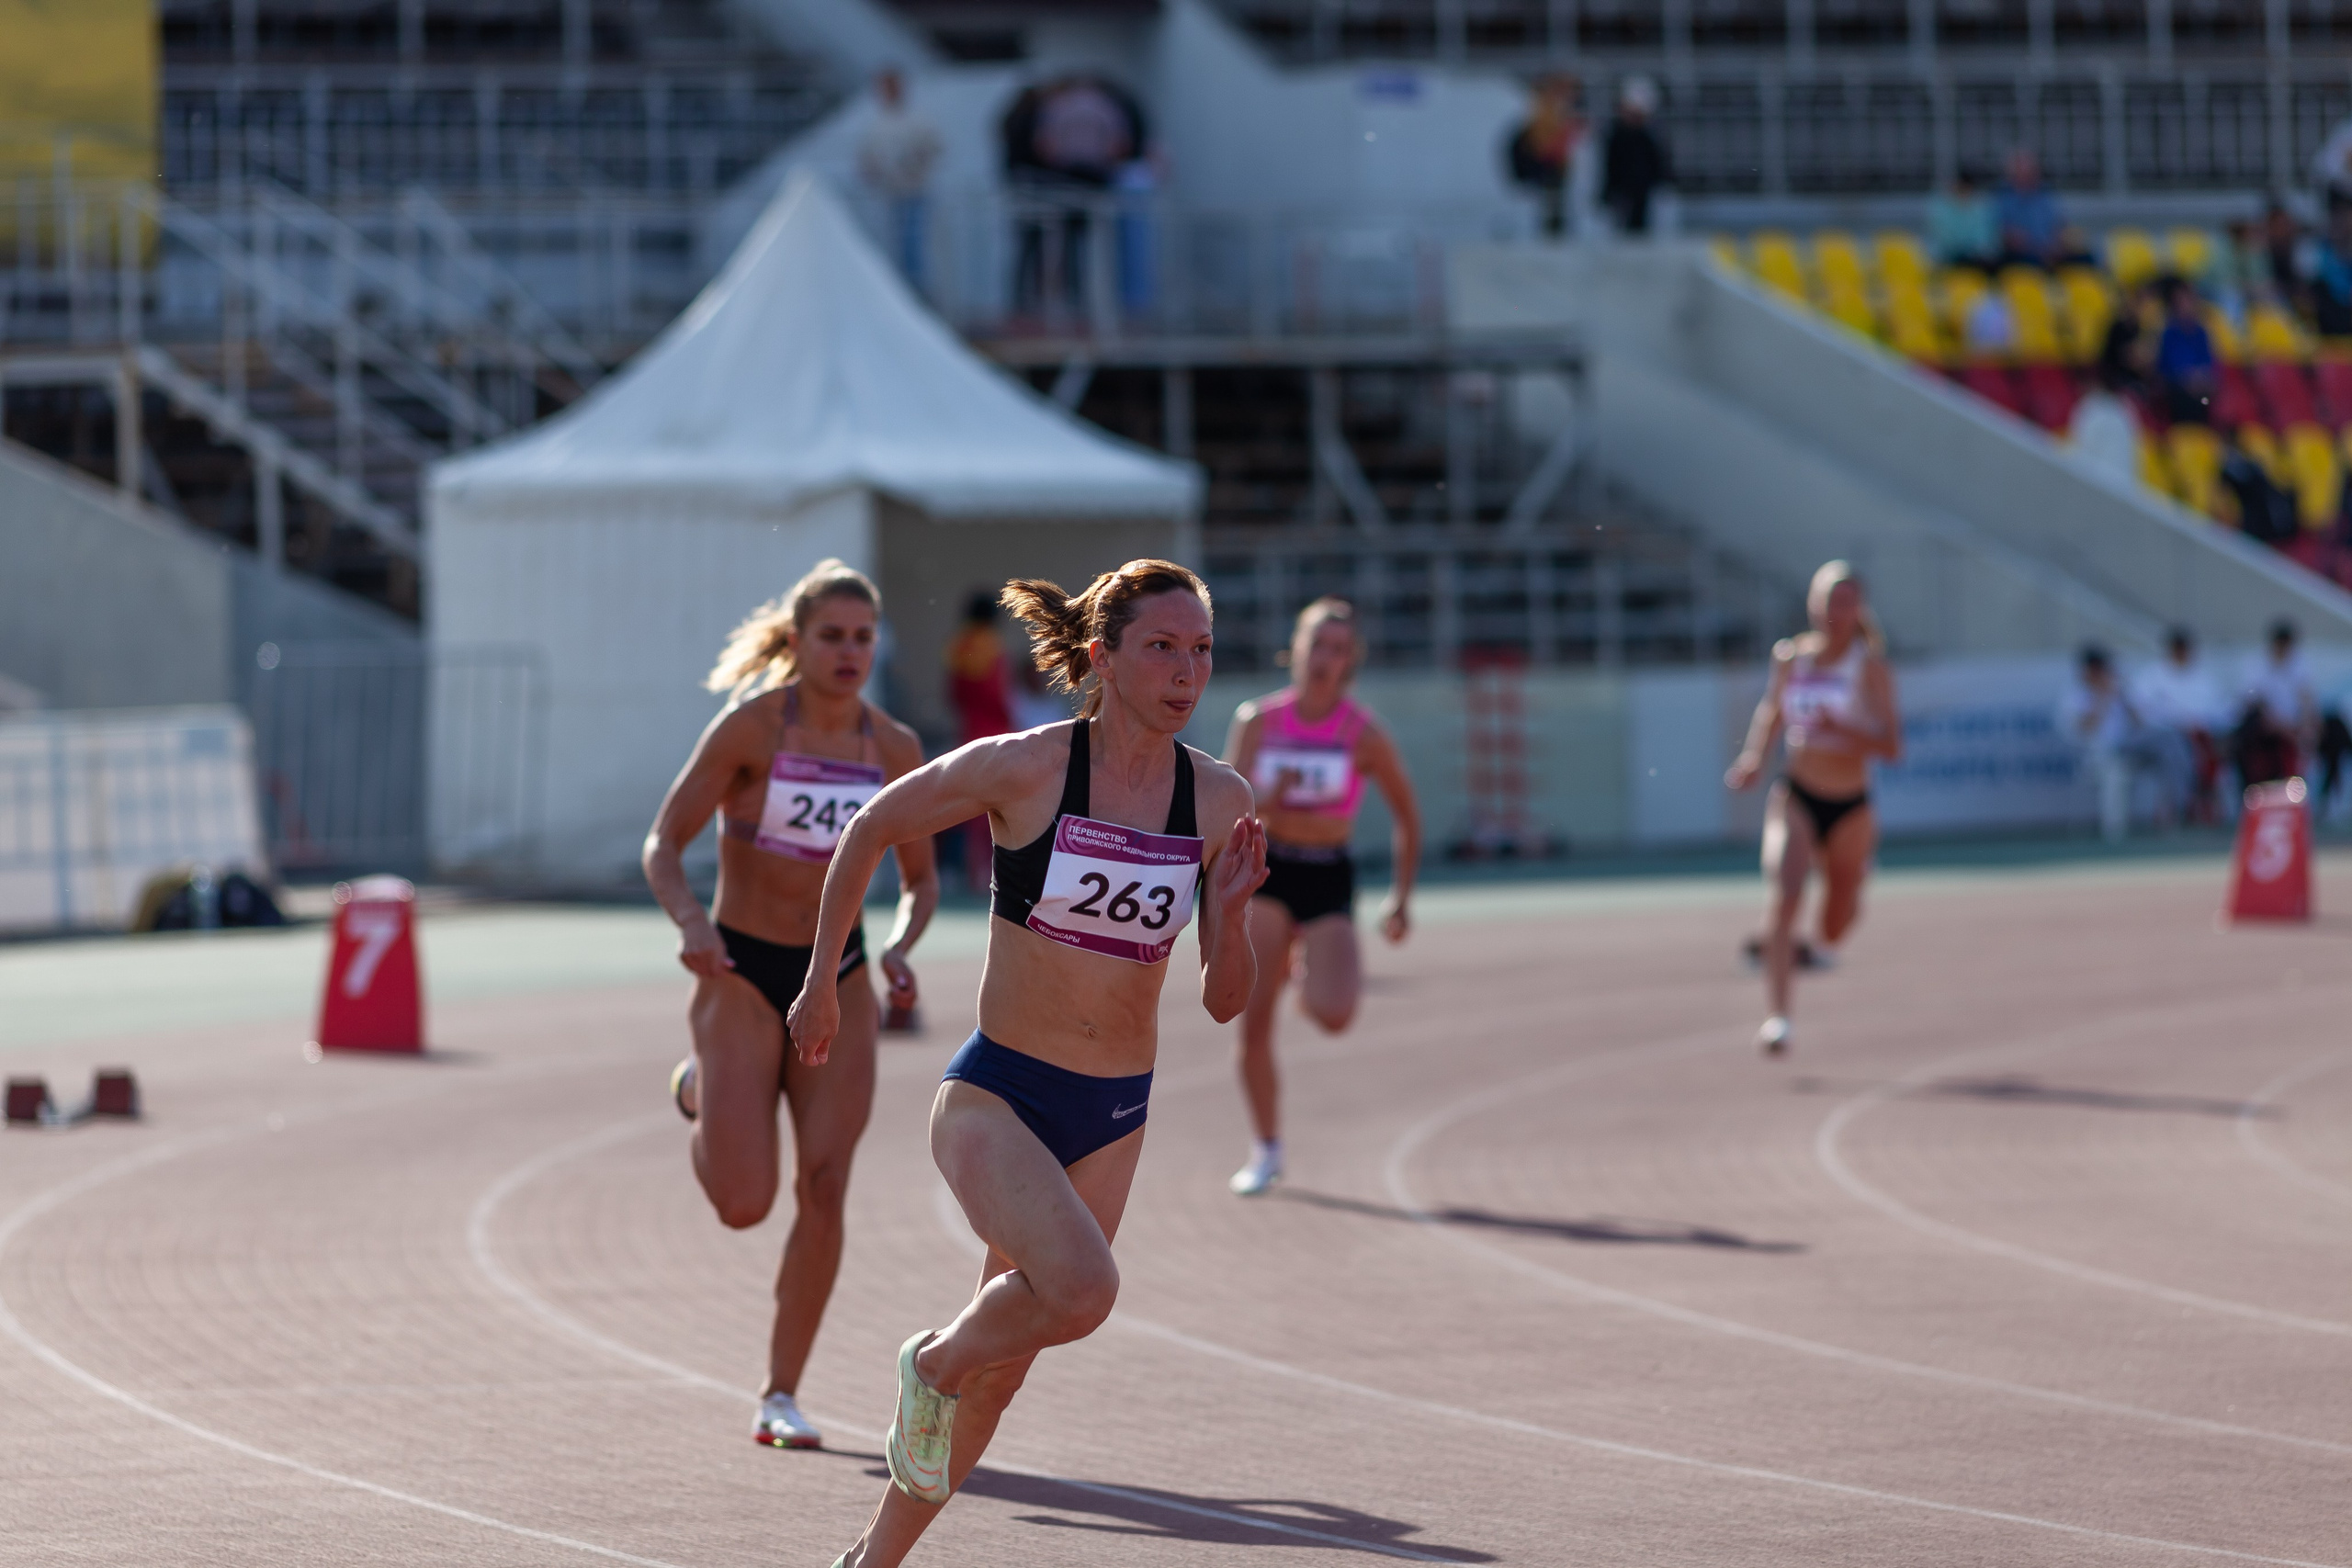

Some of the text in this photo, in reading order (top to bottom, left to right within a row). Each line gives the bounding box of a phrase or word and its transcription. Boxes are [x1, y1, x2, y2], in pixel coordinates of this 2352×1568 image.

[1067, 833, 1122, 852] ПРИВОЛЖСКОГО
[1069, 825, 1127, 844] ПЕРВЕНСТВО
[1069, 872, 1176, 930] 263
[1037, 923, 1080, 944] ЧЕБОКСАРЫ
[342, 910, 400, 998] 7
